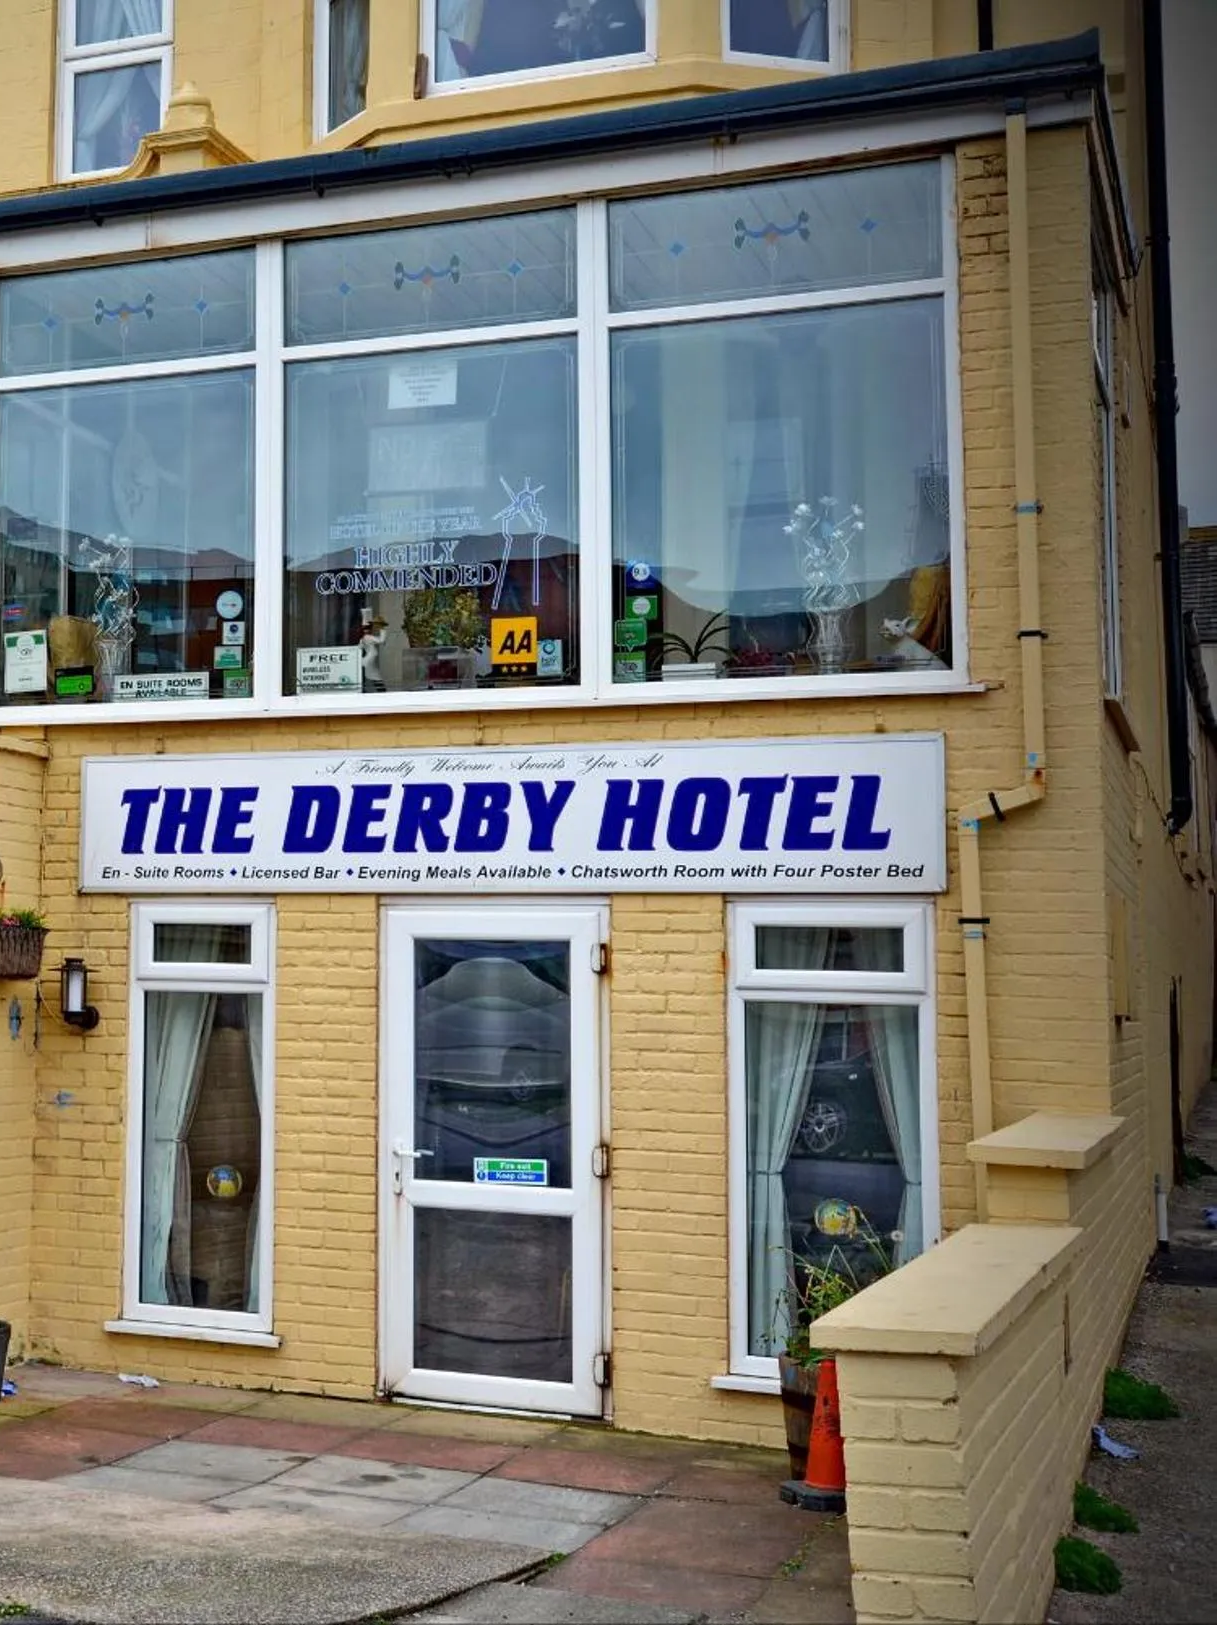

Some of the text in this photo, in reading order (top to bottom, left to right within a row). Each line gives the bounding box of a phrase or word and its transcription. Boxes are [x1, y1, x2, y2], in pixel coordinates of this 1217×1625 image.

[354, 540, 460, 569] HIGHLY
[315, 562, 498, 596] COMMENDED
[498, 629, 532, 655] AA
[309, 653, 350, 663] FREE
[120, 678, 203, 689] EN SUITE ROOMS
[346, 758, 415, 777] Friendly
[431, 757, 494, 772] Welcome
[578, 754, 618, 775] You
[120, 774, 891, 854] THE DERBY HOTEL
[102, 867, 121, 879] En
[133, 866, 169, 879] Suite
[173, 866, 224, 879] Rooms
[241, 866, 309, 879] Licensed
[313, 866, 341, 879] Bar
[358, 866, 421, 881] Evening
[426, 865, 471, 879] Meals
[476, 865, 552, 879] Available
[571, 865, 668, 879] Chatsworth
[674, 865, 725, 878] Room
[730, 864, 767, 878] with
[773, 864, 816, 878] Four
[820, 864, 881, 878] Poster
[886, 864, 924, 878] Bed
[499, 1161, 515, 1170] Fire
[495, 1172, 515, 1181] Keep
